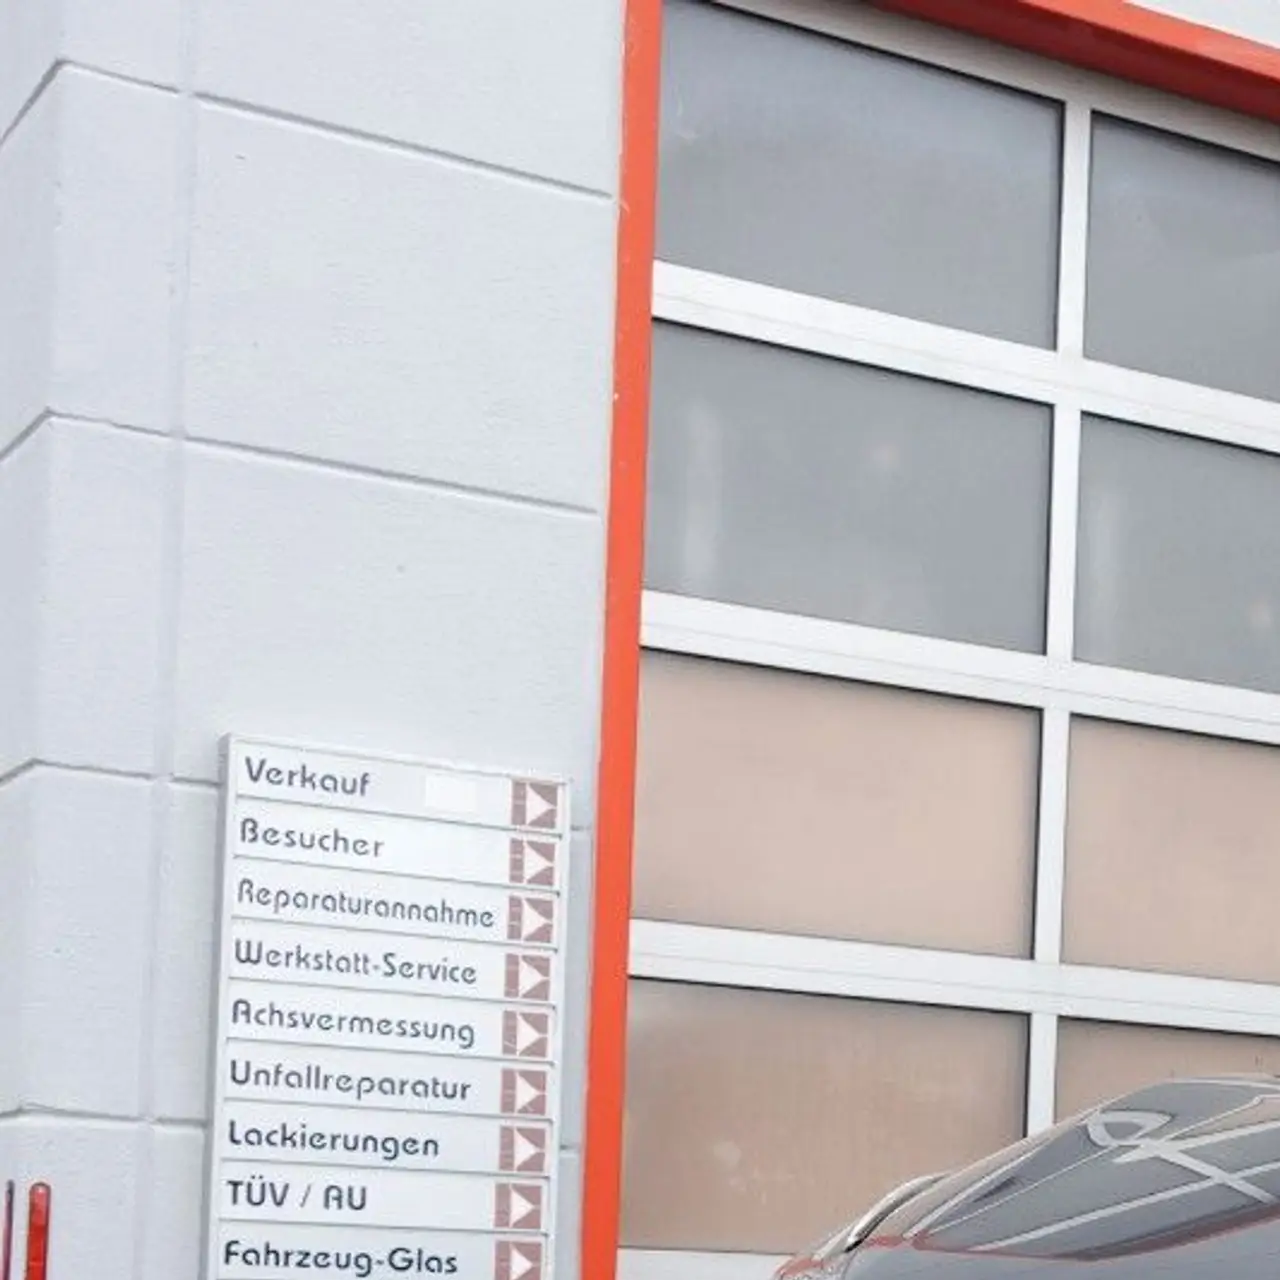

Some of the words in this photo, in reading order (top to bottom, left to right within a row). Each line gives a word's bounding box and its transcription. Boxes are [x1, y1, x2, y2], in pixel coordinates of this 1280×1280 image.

[244, 756, 371, 796] Verkauf
[239, 818, 385, 857] Besucher
[237, 877, 495, 928] Reparaturannahme
[234, 938, 477, 985] Werkstatt-Service
[231, 998, 476, 1049] Achsvermessung
[229, 1060, 471, 1101] Unfallreparatur
[228, 1120, 440, 1160] Lackierungen
[226, 1174, 289, 1206] TÜV
[323, 1184, 368, 1210] AU
[223, 1240, 458, 1277] Fahrzeug-Glas
